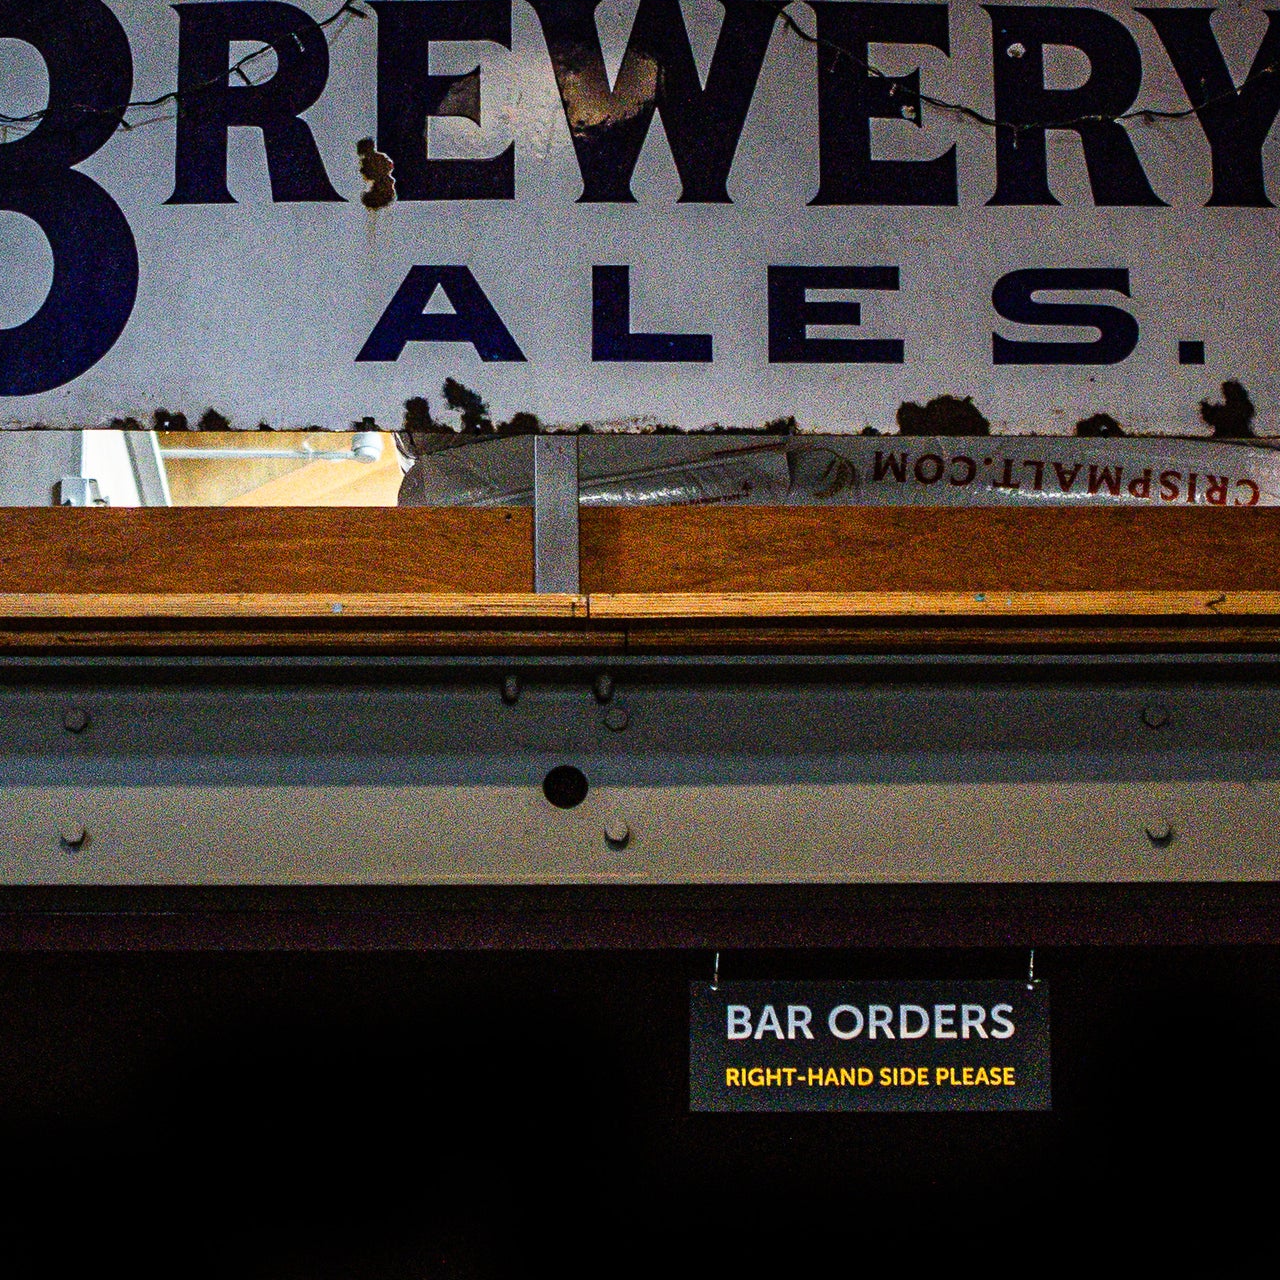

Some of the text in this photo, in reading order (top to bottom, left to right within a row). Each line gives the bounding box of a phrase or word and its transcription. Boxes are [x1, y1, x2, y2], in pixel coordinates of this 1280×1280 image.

[354, 265, 1205, 365] ALES.
[872, 450, 1261, 506] CRISPMALT.COM
[726, 1003, 1016, 1041] BAR ORDERS
[725, 1066, 1017, 1088] RIGHT-HAND SIDE PLEASE
